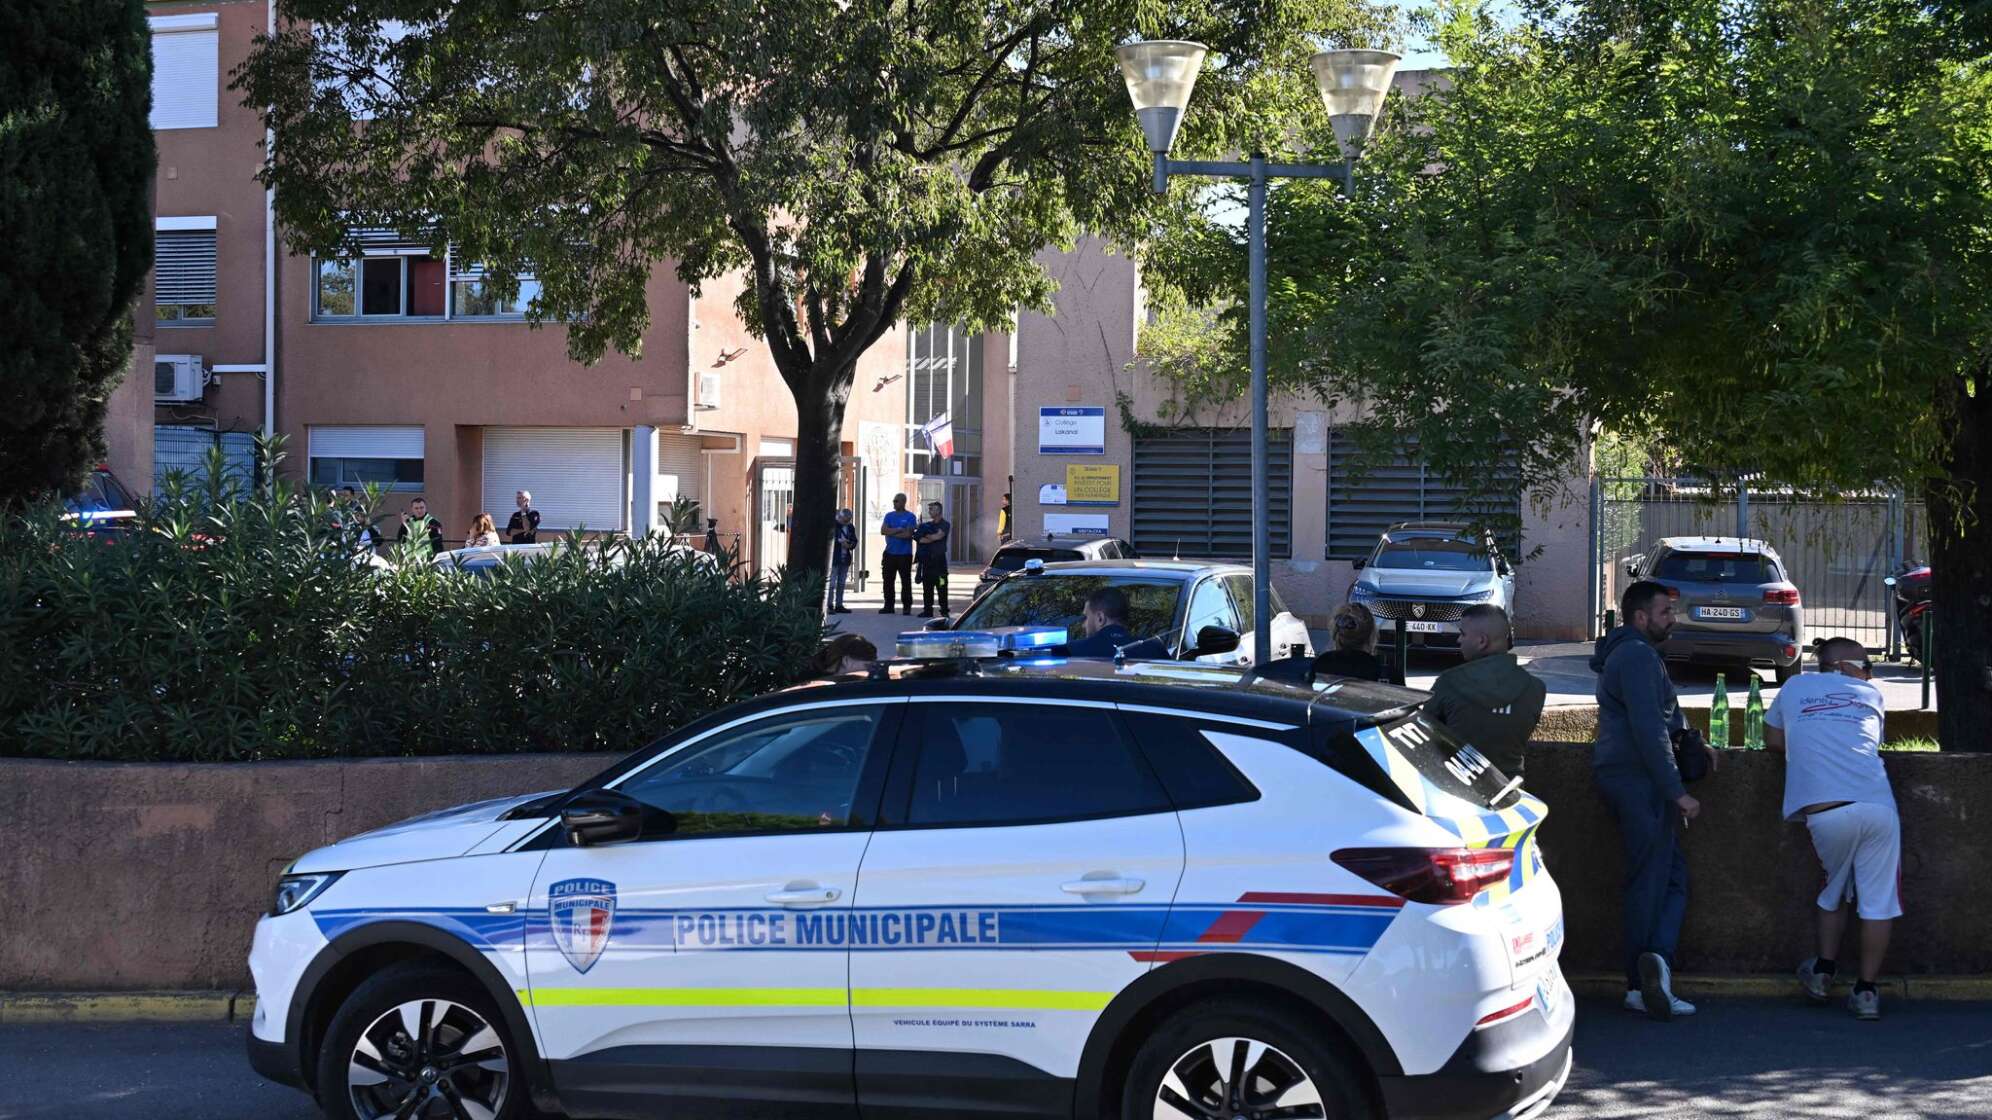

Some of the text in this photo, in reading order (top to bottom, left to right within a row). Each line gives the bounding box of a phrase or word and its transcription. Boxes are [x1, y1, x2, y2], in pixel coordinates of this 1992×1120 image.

[553, 881, 610, 895] POLICE
[555, 899, 610, 910] MUNICIPALE
[676, 912, 997, 945] POLICE MUNICIPALE
